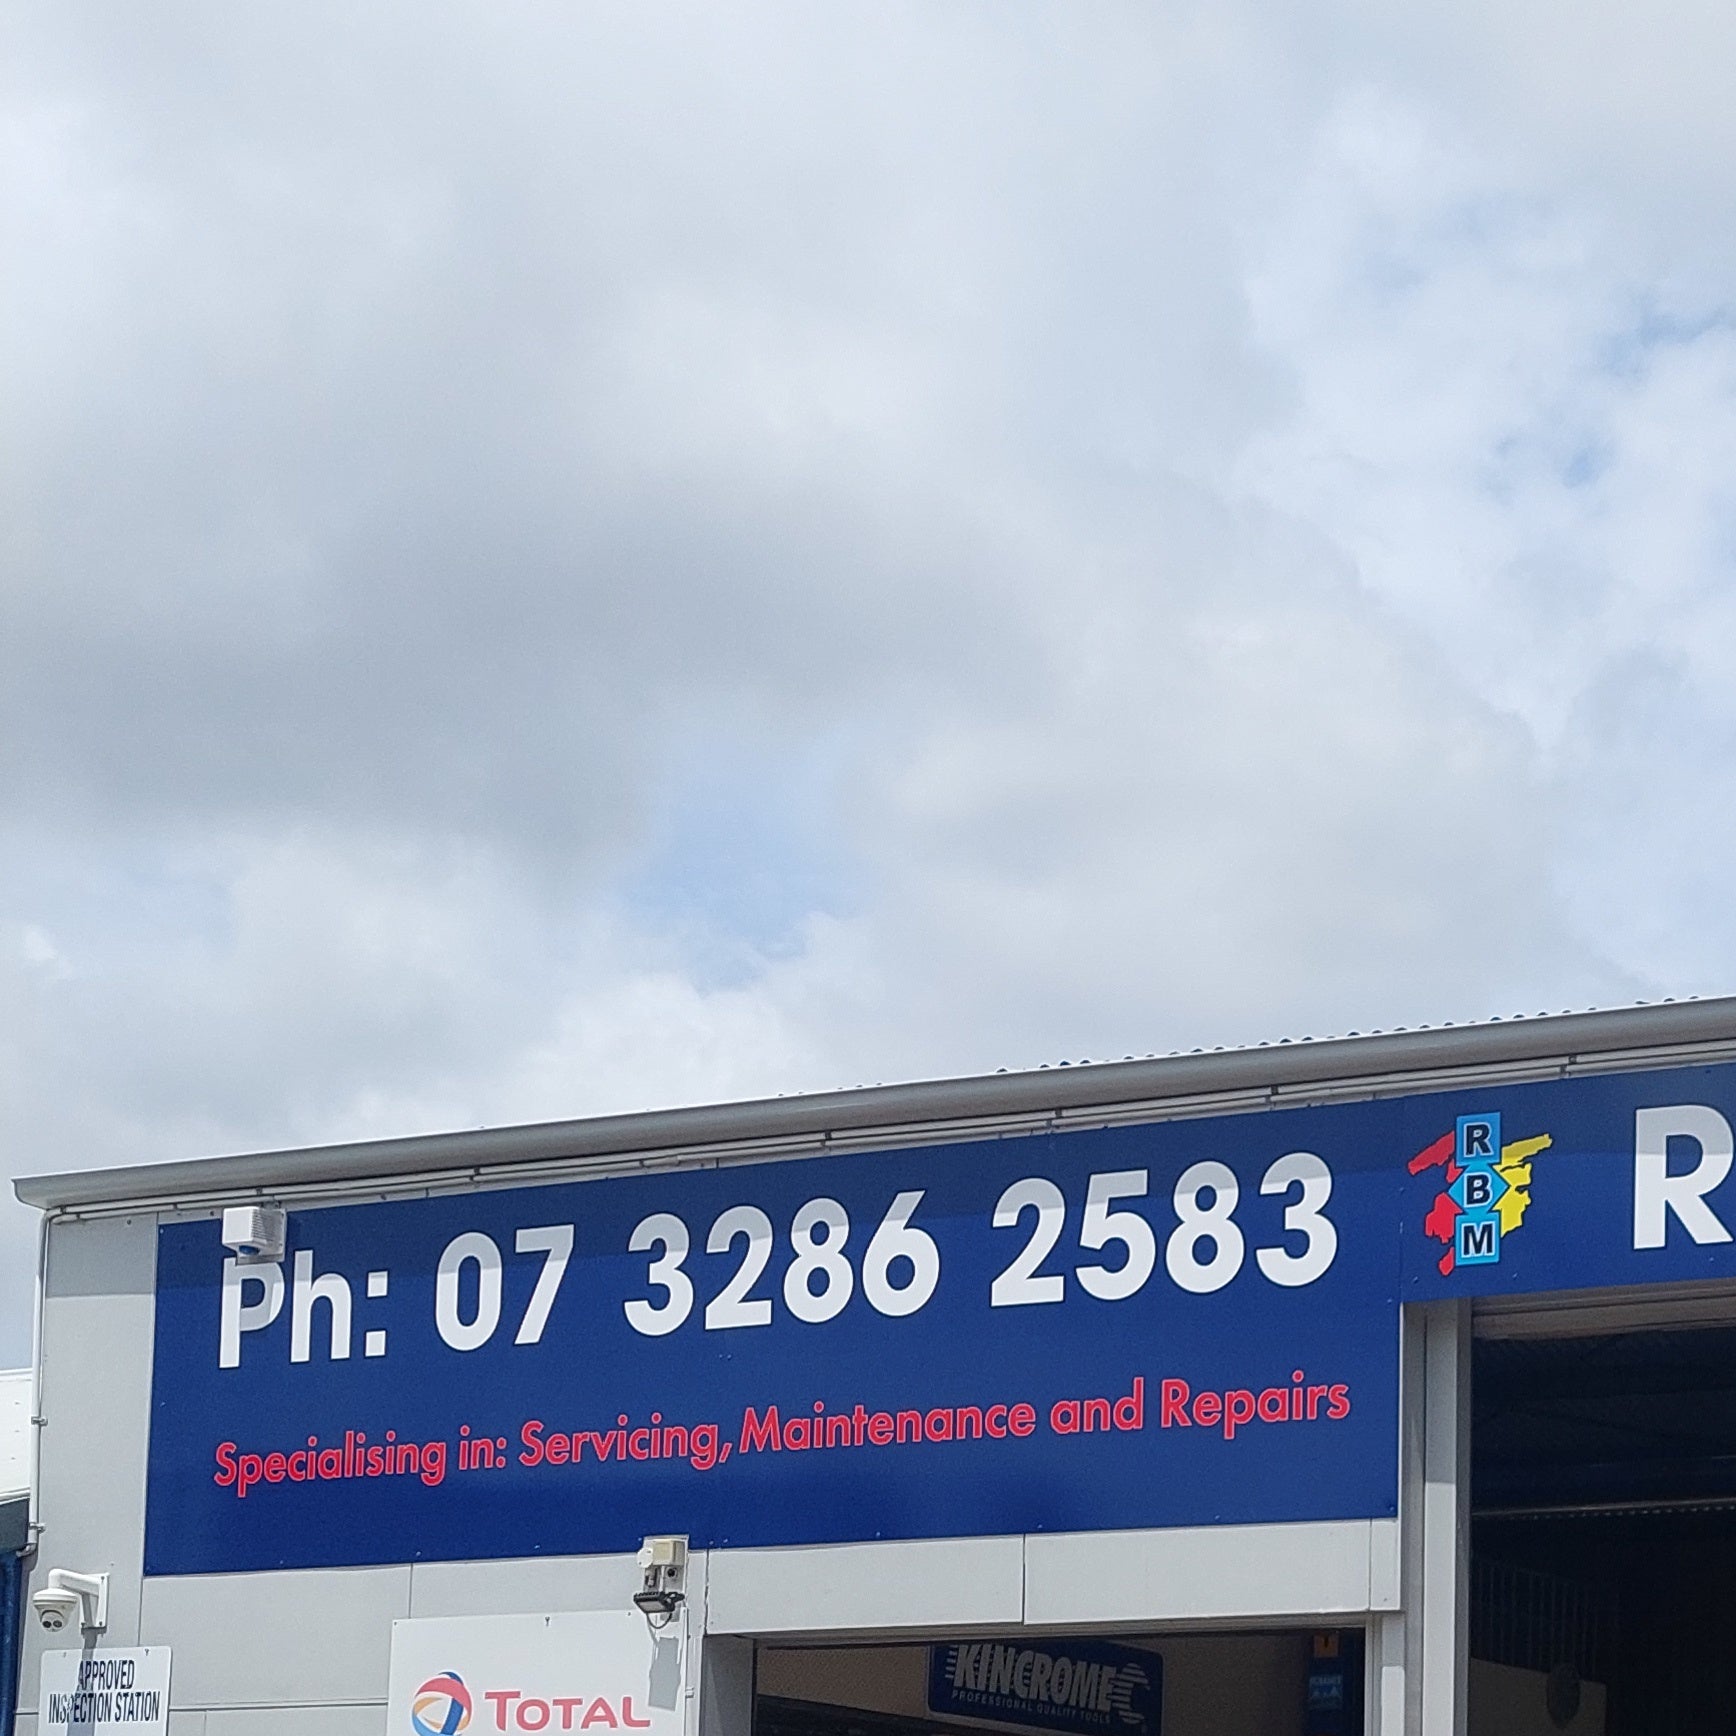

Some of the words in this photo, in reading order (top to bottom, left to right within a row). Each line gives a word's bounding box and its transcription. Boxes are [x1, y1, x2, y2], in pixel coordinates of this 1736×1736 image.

[1462, 1122, 1497, 1258] RBM
[218, 1250, 389, 1369] Ph:
[434, 1224, 575, 1352] 07
[623, 1190, 940, 1337] 3286
[990, 1151, 1338, 1307] 2583
[213, 1431, 447, 1498] Specialising
[458, 1425, 507, 1470] in:
[518, 1412, 732, 1471] Servicing,
[740, 1402, 1036, 1453] Maintenance
[1050, 1377, 1144, 1436] and
[1161, 1370, 1351, 1440] Repairs
[77, 1660, 135, 1690] APPROVED
[952, 1643, 1118, 1713] KINCROME
[48, 1692, 112, 1723] INSPECTION
[114, 1691, 160, 1722] STATION
[484, 1691, 651, 1732] TOTAL
[952, 1690, 1033, 1713] PROFESSIONAL
[1037, 1701, 1077, 1720] QUALITY
